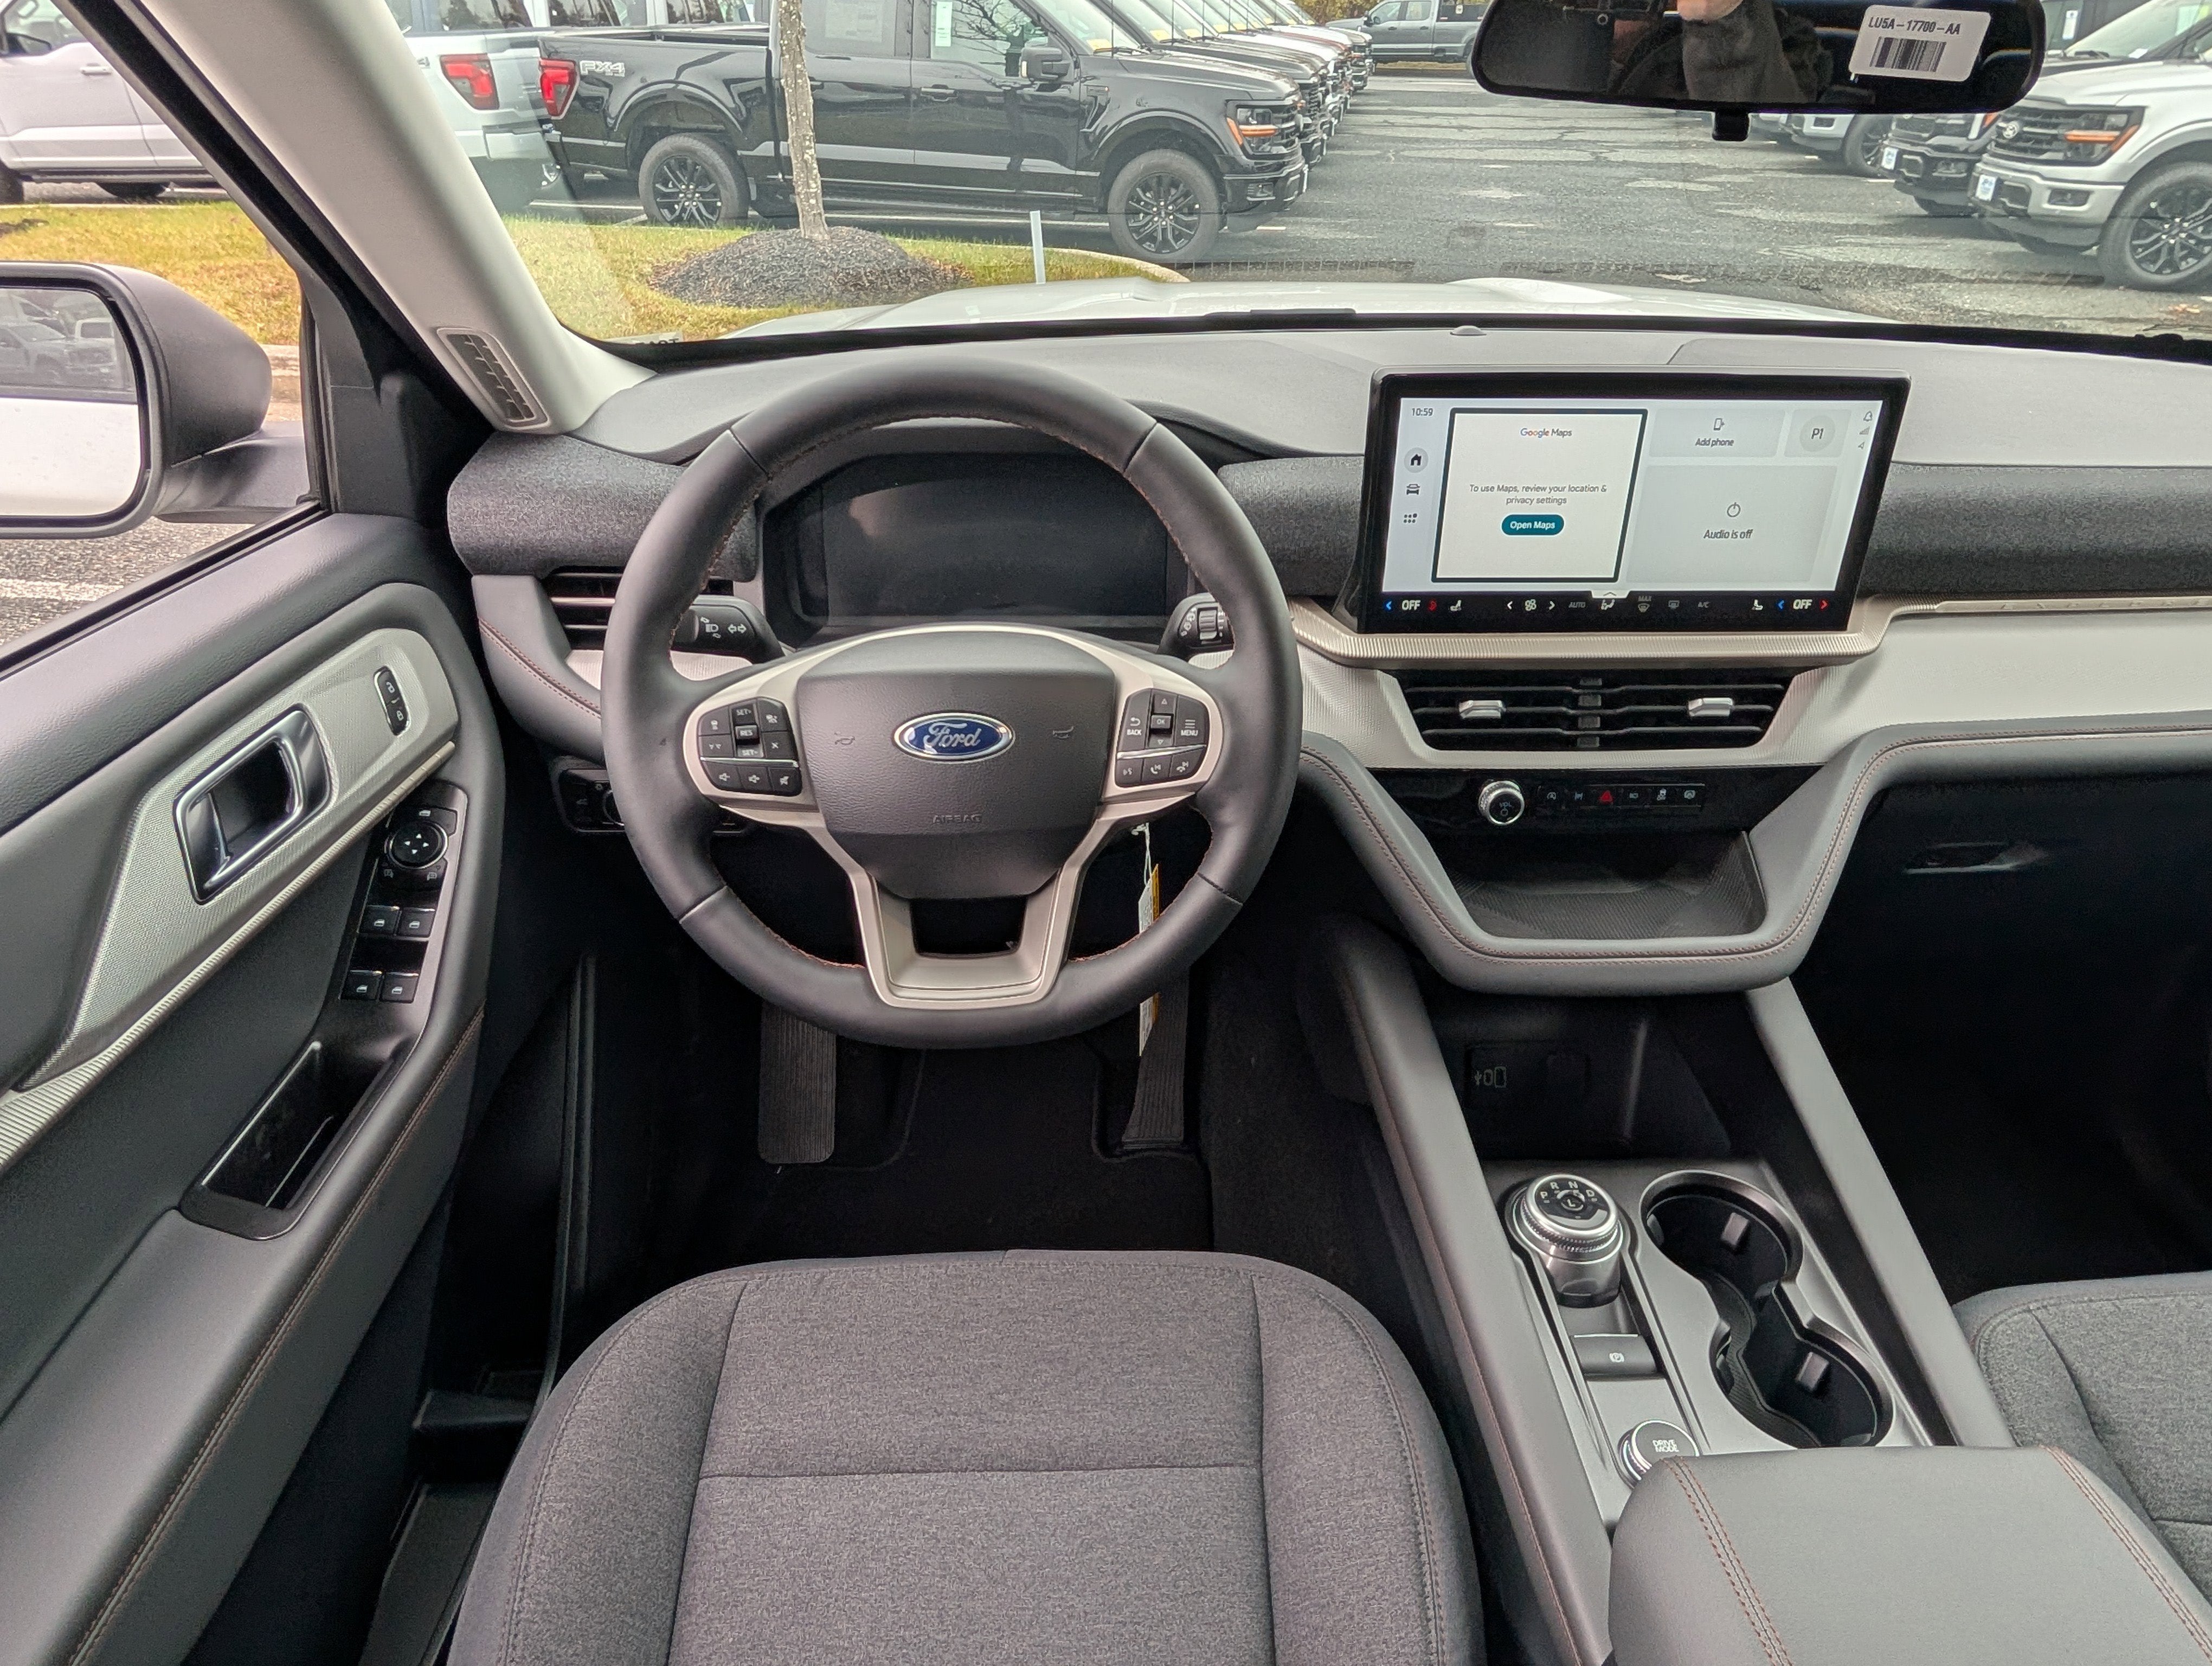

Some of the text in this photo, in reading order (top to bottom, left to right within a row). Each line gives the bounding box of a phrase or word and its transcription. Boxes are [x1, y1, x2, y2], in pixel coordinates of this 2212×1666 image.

[580, 60, 625, 77] FX4
[1411, 407, 1433, 416] 10:59
[1520, 427, 1573, 438] Google Maps
[1811, 428, 1824, 440] P1
[1695, 438, 1734, 448] Add phone
[1470, 484, 1479, 492] To
[1497, 484, 1519, 494] Maps,
[1522, 484, 1547, 492] review
[1548, 485, 1566, 494] your
[1568, 484, 1599, 492] location
[1506, 496, 1567, 505] privacy settings
[1510, 521, 1555, 531] Open Maps
[1703, 529, 1753, 539] Audio is off
[1401, 599, 1421, 611] OFF
[1793, 599, 1813, 610] OFF
[923, 722, 982, 748] Ford
[933, 813, 983, 823] AIRBAG
[1540, 1191, 1548, 1199] P
[1567, 1199, 1576, 1207] L
